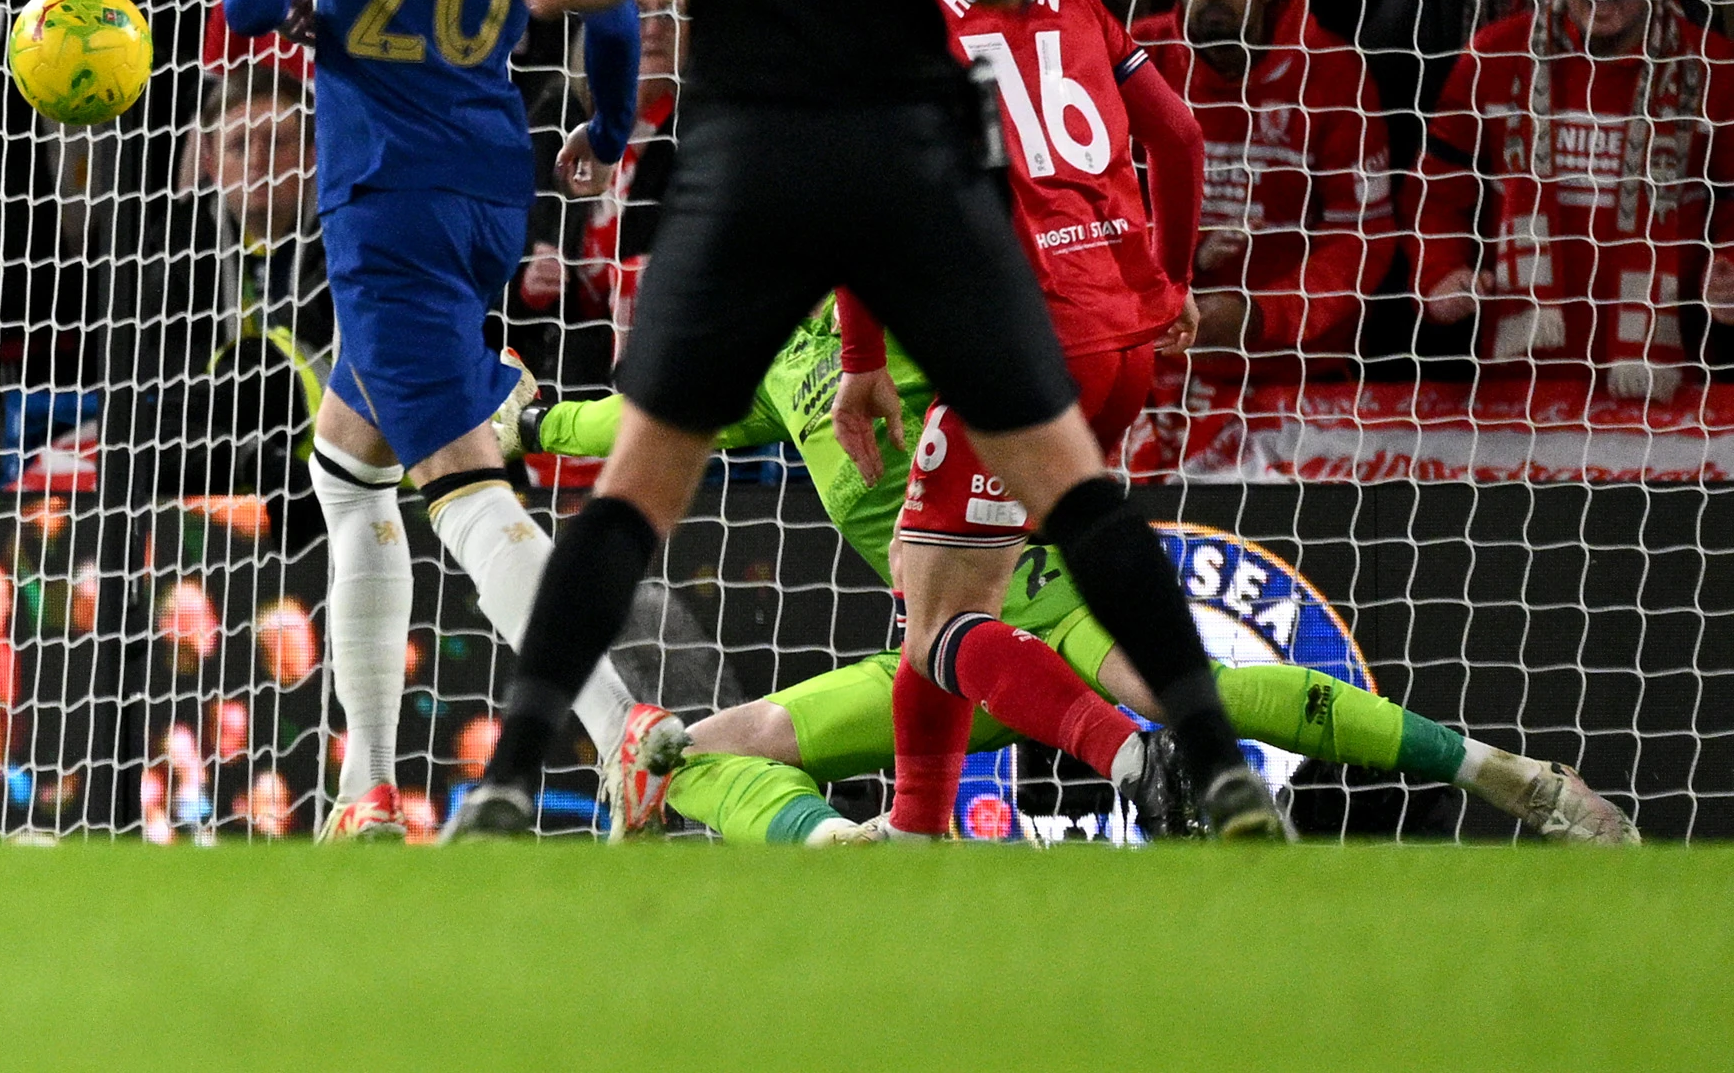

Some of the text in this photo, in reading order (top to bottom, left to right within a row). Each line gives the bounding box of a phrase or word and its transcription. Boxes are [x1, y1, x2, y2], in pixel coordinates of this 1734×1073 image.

[958, 30, 1112, 178] 16
[1556, 127, 1624, 155] NIBE
[792, 348, 843, 412] UNIBE
[970, 473, 1012, 497] BO
[1185, 544, 1303, 649] SEA
